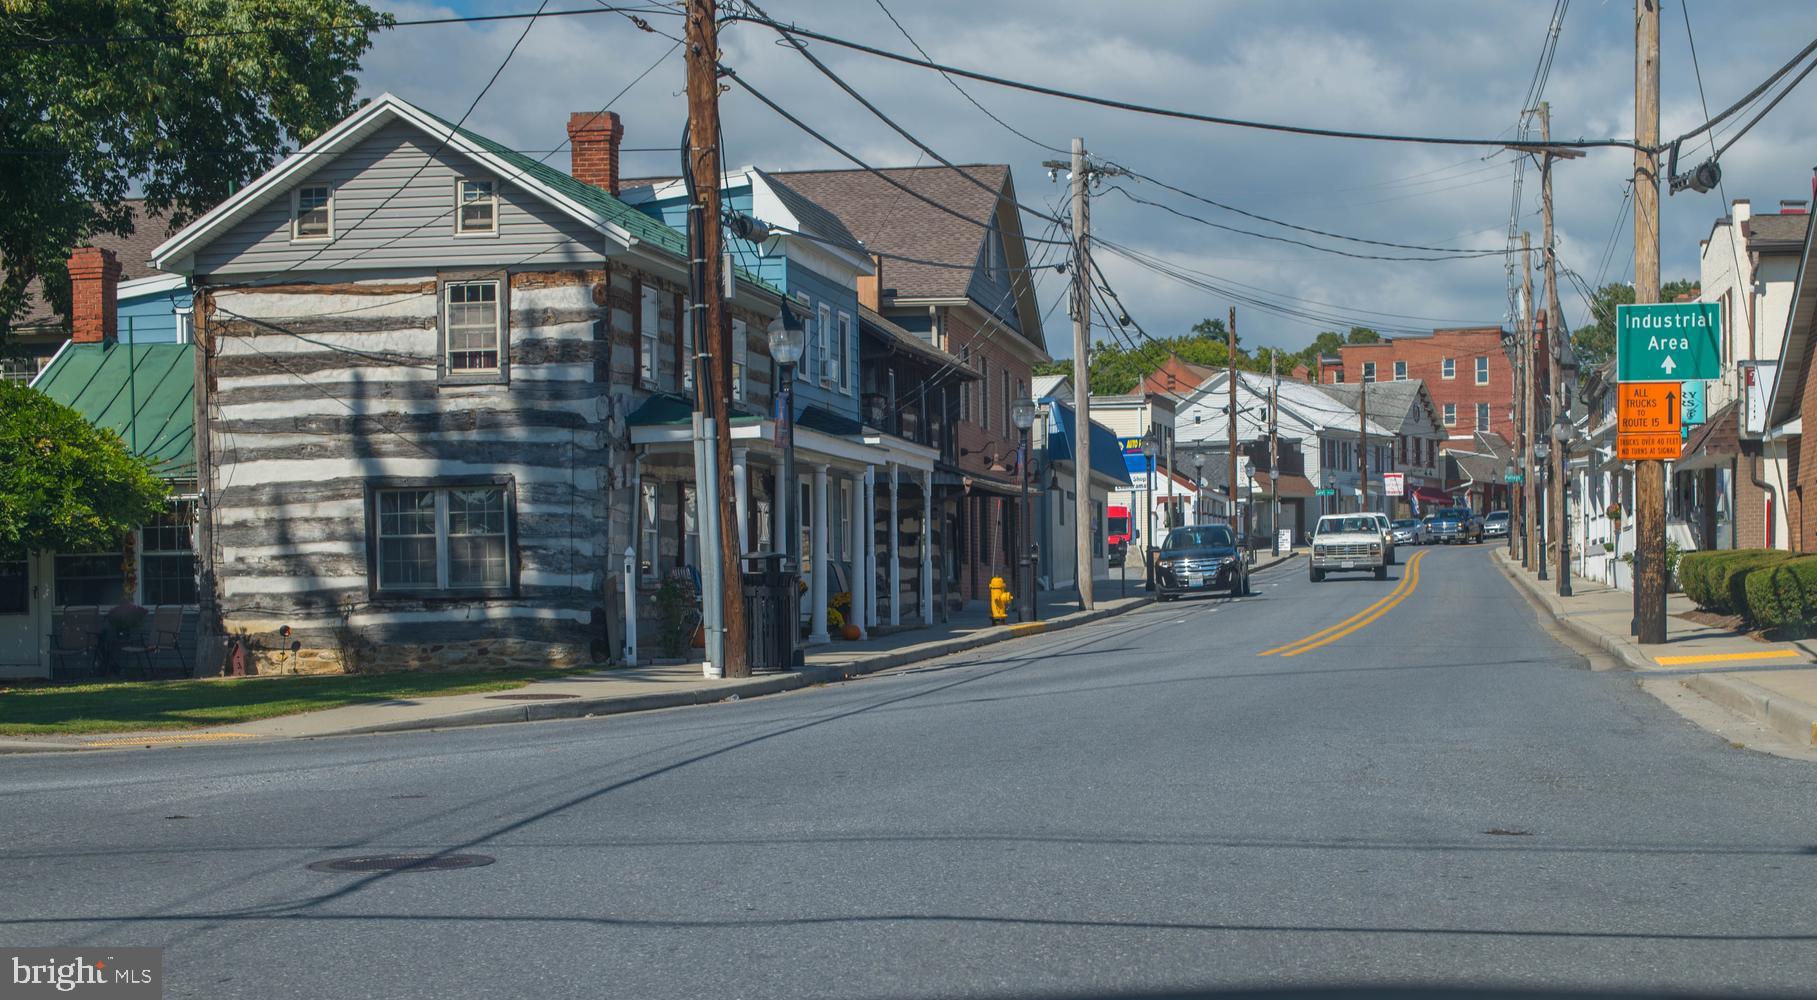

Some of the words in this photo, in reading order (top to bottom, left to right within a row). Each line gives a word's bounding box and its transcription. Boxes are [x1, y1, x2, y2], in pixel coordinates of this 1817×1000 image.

[1625, 312, 1712, 329] Industrial
[1647, 335, 1689, 350] Area
[1634, 389, 1648, 397] ALL
[1626, 400, 1657, 408] TRUCKS
[1622, 418, 1648, 427] ROUTE
[1652, 418, 1660, 427] 15
[1620, 438, 1640, 446] TRUCKS
